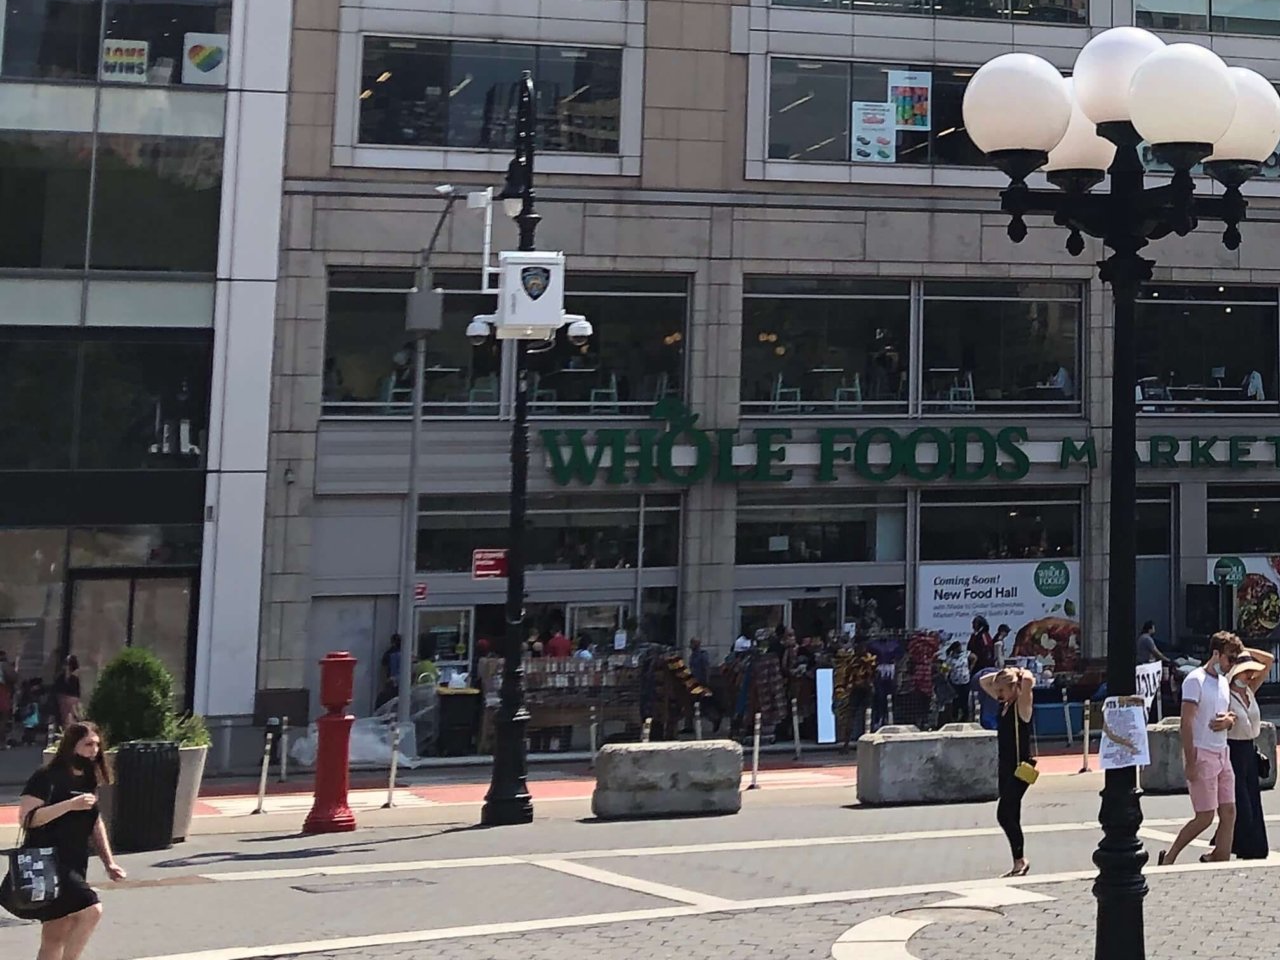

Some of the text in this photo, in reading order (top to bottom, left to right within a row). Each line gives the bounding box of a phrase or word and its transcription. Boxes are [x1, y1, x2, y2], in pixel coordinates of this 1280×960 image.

[104, 46, 146, 58] LOVE
[103, 62, 145, 76] WINS
[538, 426, 793, 485] WHOLE
[815, 425, 1031, 483] FOODS
[933, 574, 1001, 587] Coming Soon!
[934, 586, 1018, 600] New Food Hall
